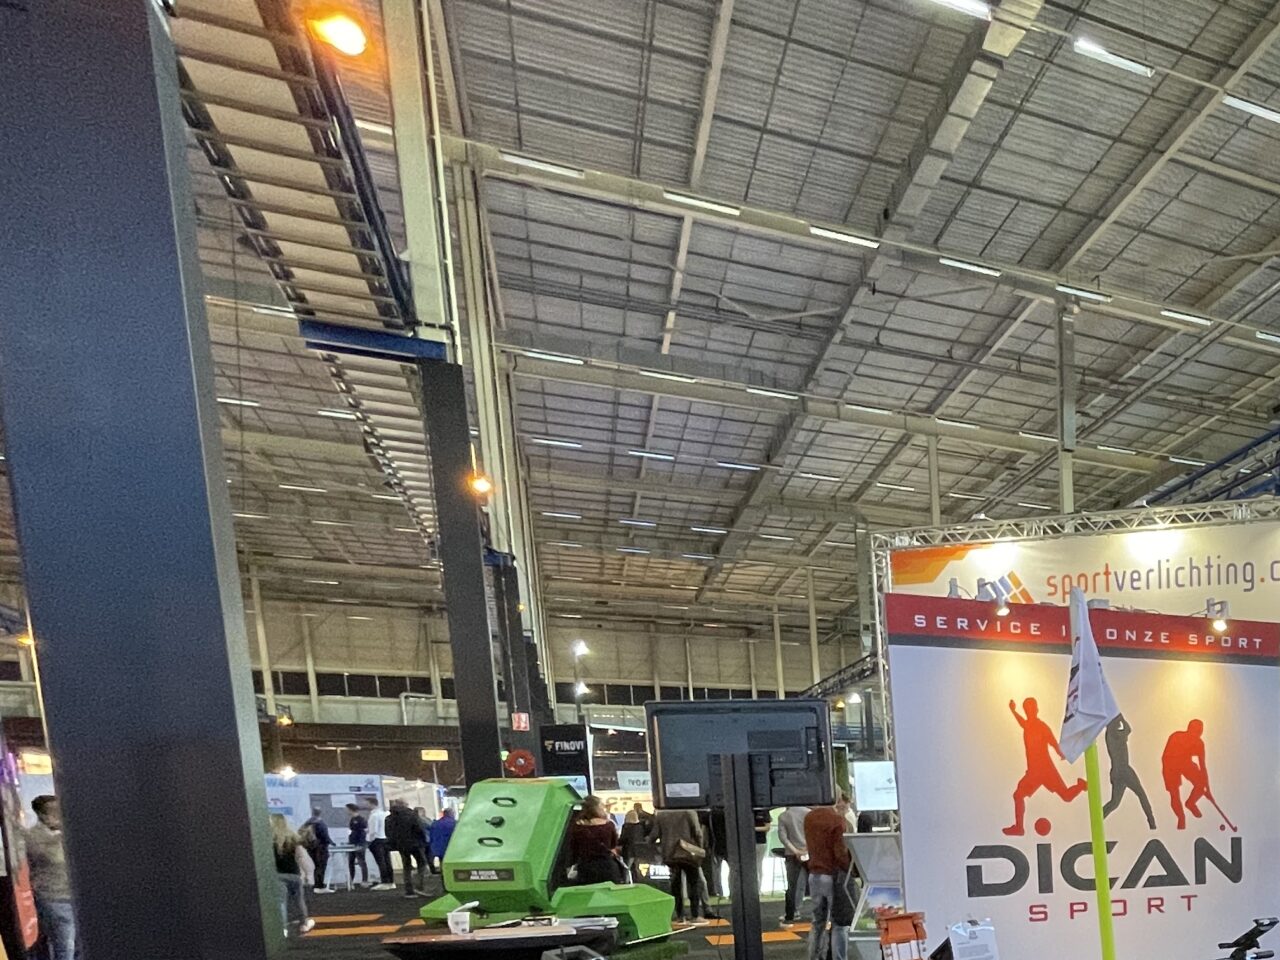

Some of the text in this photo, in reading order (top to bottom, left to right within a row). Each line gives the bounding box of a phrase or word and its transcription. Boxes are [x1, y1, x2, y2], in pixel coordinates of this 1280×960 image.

[914, 614, 1042, 636] SERVICE
[1105, 628, 1171, 644] ONZE
[1187, 633, 1264, 650] SPORT
[966, 837, 1244, 898] DICAN
[1028, 894, 1198, 923] SPORT
